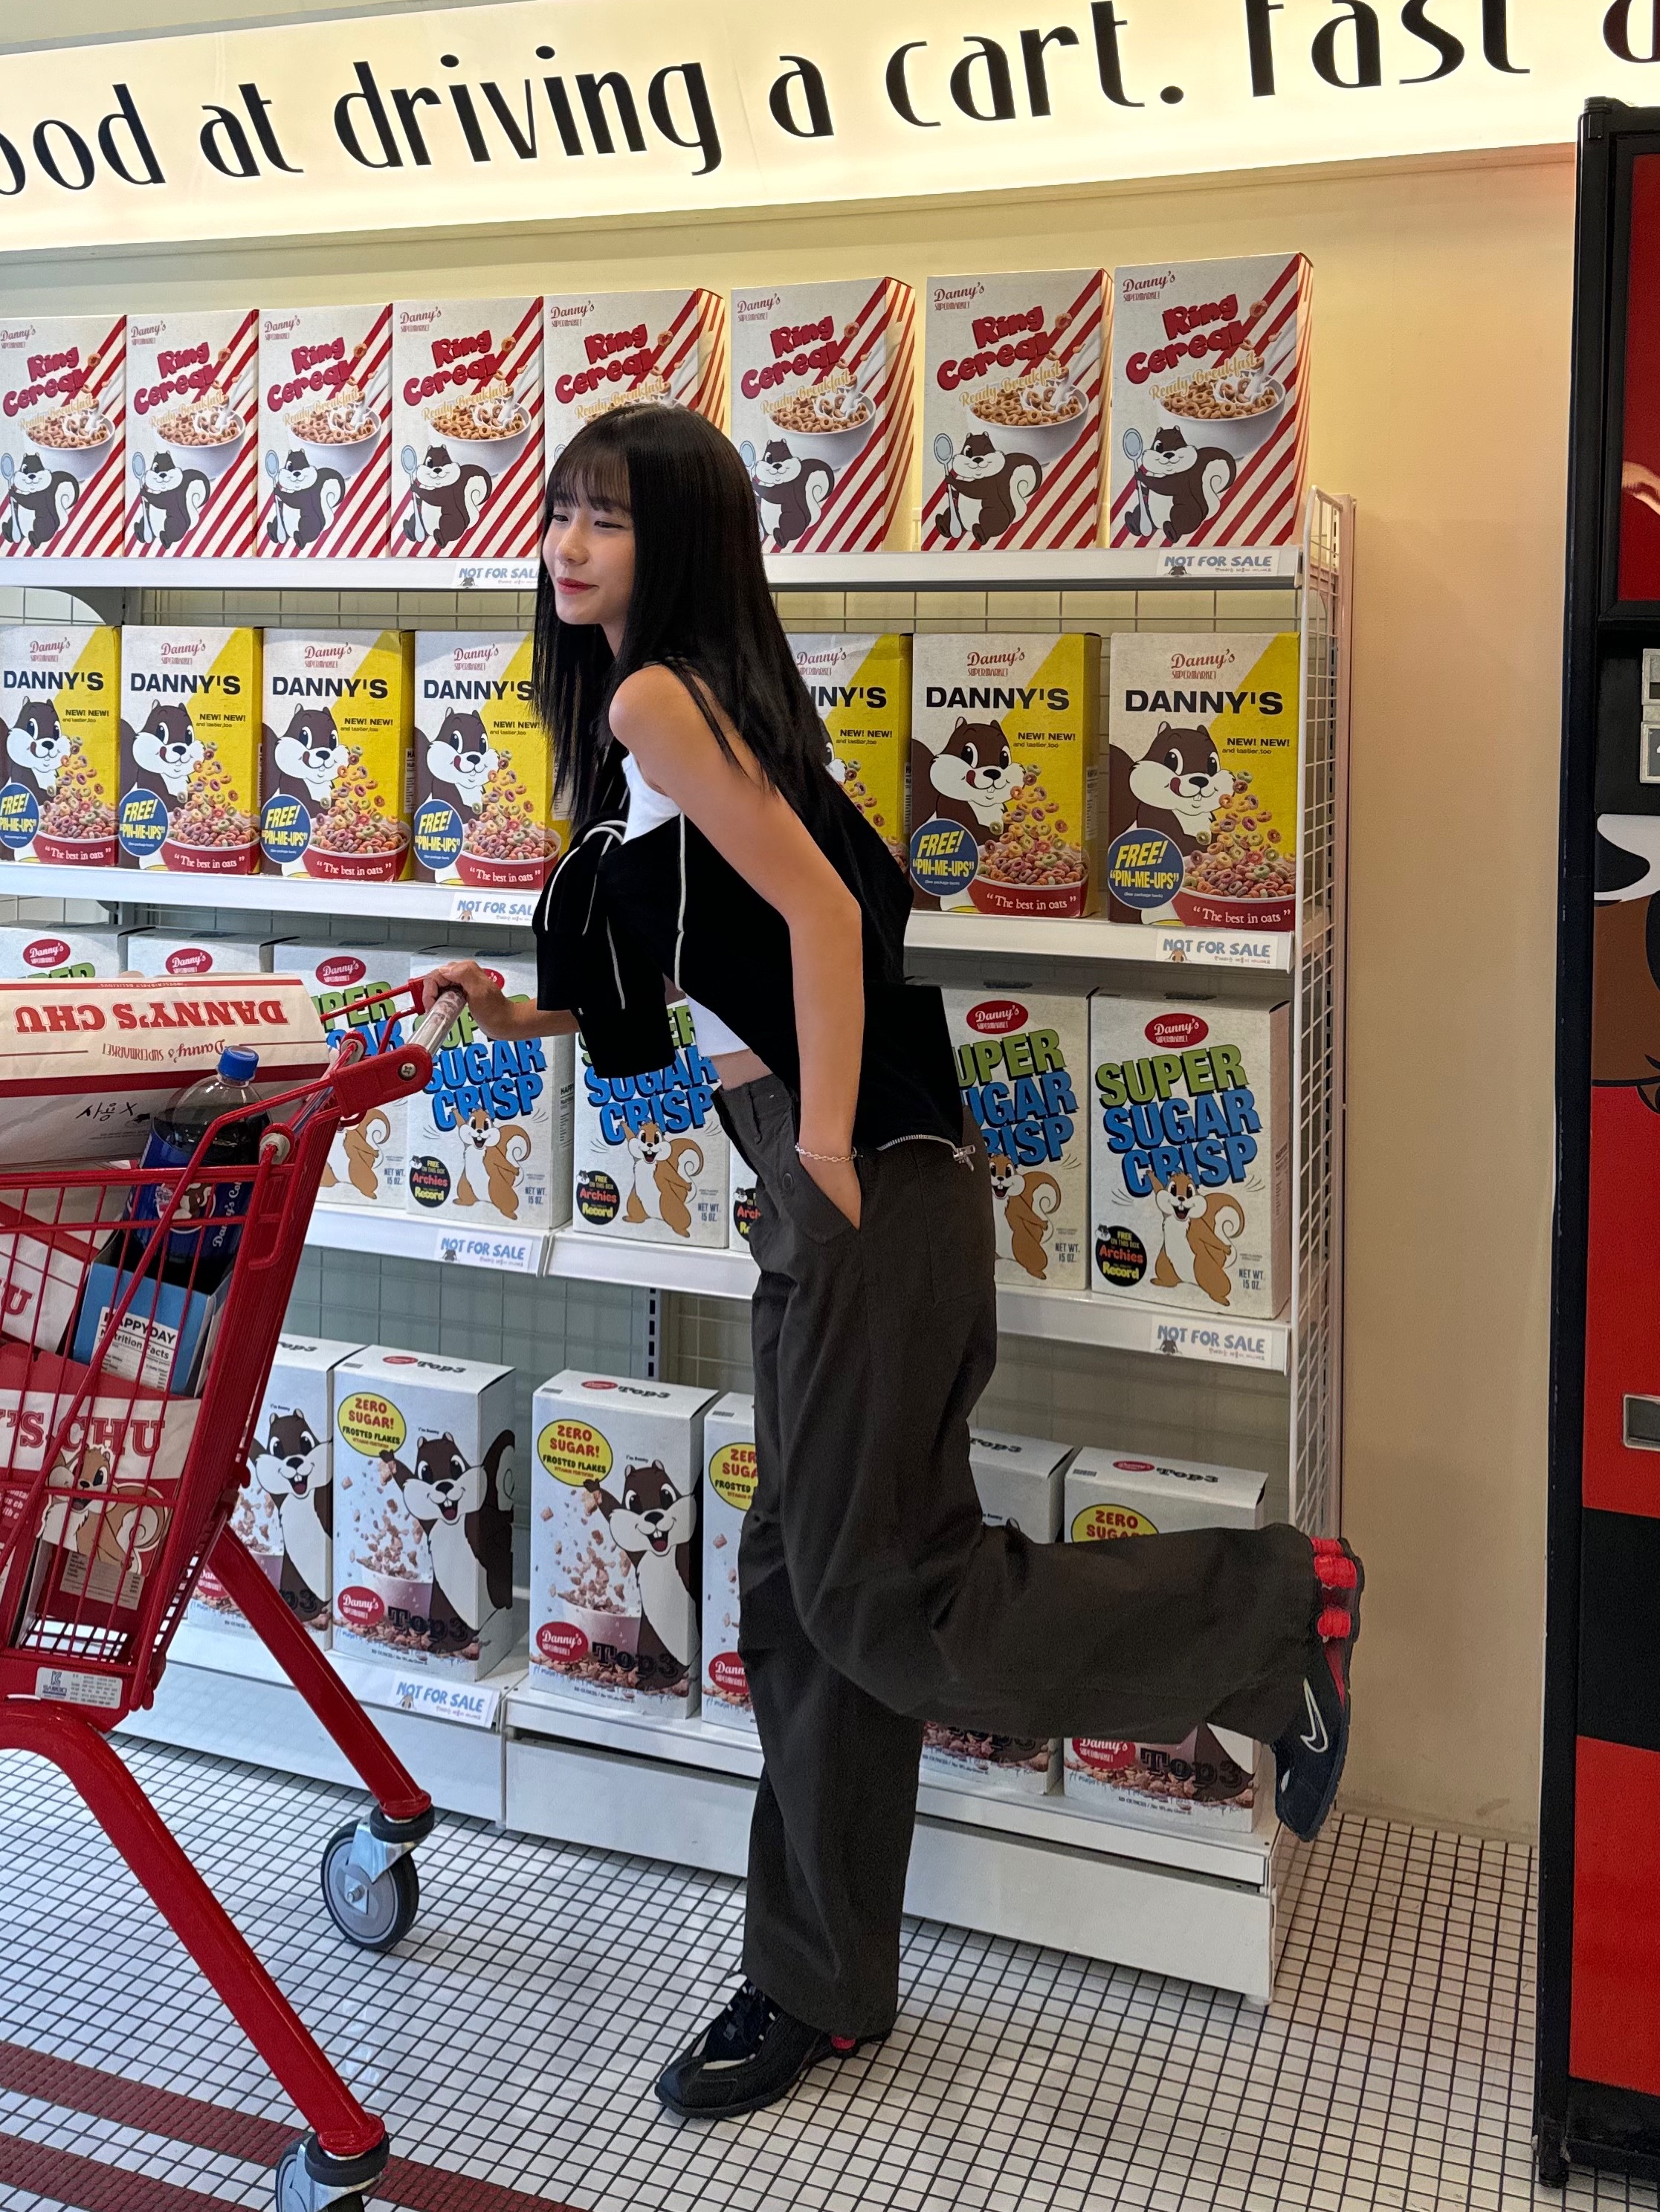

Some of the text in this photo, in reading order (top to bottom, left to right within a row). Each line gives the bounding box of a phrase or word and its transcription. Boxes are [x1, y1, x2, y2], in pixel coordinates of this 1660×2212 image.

[198, 83, 305, 178] at
[334, 45, 723, 176] driving
[769, 55, 833, 138] a
[885, 0, 1184, 127] cart.
[934, 282, 985, 303] Danny's
[1123, 271, 1176, 293] Danny's
[551, 300, 595, 320] Danny's
[737, 294, 781, 314] Danny's
[400, 307, 442, 325] Danny's
[1162, 294, 1238, 341] Ring
[770, 316, 835, 358] Ring
[972, 305, 1044, 349] Ring
[431, 330, 493, 368] Ring
[584, 324, 648, 364] Ring
[27, 347, 80, 382] Ring
[157, 342, 210, 378] Ring
[291, 337, 345, 375] Ring
[1001, 361, 1066, 394] Breakfast
[1192, 351, 1257, 386] Breakfast
[797, 369, 852, 400] Breakfast
[1164, 556, 1272, 567] NOT FOR SALE
[458, 567, 483, 579] NOT
[485, 567, 508, 579] FOR
[30, 637, 70, 653] Danny's
[161, 639, 206, 656] Danny's
[304, 642, 352, 659] Danny's
[454, 644, 499, 662] Danny's
[797, 647, 847, 666] Danny's
[967, 647, 1025, 666] Danny's
[1171, 648, 1236, 669] Danny's
[4, 670, 104, 691] DANNY'S
[131, 673, 241, 694] DANNY'S
[272, 676, 388, 698] DANNY'S
[424, 679, 534, 700] DANNY'S
[926, 686, 1070, 710] DANNY'S
[1125, 690, 1284, 714] DANNY'S
[199, 714, 246, 722] NEW! NEW!
[369, 718, 393, 726] NEW!
[840, 729, 892, 738] NEW! NEW!
[1018, 731, 1076, 741] NEW! NEW!
[1227, 737, 1290, 748] NEW! NEW!
[1, 792, 30, 816] FREE!
[123, 798, 158, 823] FREE!
[265, 804, 300, 829] FREE!
[418, 809, 451, 835] FREE!
[917, 830, 964, 858] FREE!
[1114, 840, 1169, 869] FREE!
[340, 864, 355, 876] best
[357, 864, 366, 876] in
[457, 900, 533, 916] NOT FOR SAL
[1015, 897, 1034, 911] best
[1036, 898, 1047, 911] in
[1224, 911, 1246, 924] best
[1247, 911, 1259, 924] in
[1163, 939, 1271, 957] NOT FOR SALE
[322, 960, 360, 977] Danny's
[14, 1000, 288, 1035] DANNY'S CHU
[975, 1005, 1020, 1023] Danny's
[1154, 1019, 1200, 1036] Danny's
[168, 1038, 225, 1063] Danny's
[952, 1029, 1068, 1087] UPER
[1096, 1044, 1249, 1108] SUPER
[431, 1073, 543, 1132] CRISP
[960, 1070, 1080, 1129] UGAR
[1103, 1088, 1263, 1154] SUGAR
[980, 1114, 1074, 1166] RISP
[1121, 1134, 1258, 1198] CRISP
[412, 1172, 448, 1188] Archies
[414, 1187, 444, 1201] Record
[580, 1188, 617, 1203] Archies
[582, 1202, 614, 1218] Record
[441, 1236, 526, 1260] NOT FOR SALE
[1099, 1244, 1144, 1264] Archies
[1102, 1261, 1140, 1280] Record
[1157, 1325, 1266, 1354] NOT FOR SALE
[355, 1397, 387, 1414] ZERO
[348, 1410, 395, 1430] SUGAR!
[342, 1426, 372, 1439] FROSTED
[374, 1432, 401, 1445] FLAKES
[557, 1425, 592, 1441] ZERO
[549, 1437, 600, 1458] SUGAR!
[543, 1454, 607, 1474] FROSTED FLAKES
[714, 1480, 752, 1493] FROSTED
[1095, 1510, 1139, 1530] ZERO
[343, 1594, 379, 1611] Danny's
[388, 1605, 468, 1642] Top3
[541, 1629, 582, 1648] Danny's
[592, 1641, 679, 1678] Top3
[396, 1681, 485, 1713] NOT FOR SALE
[1140, 1747, 1242, 1788] Top3
